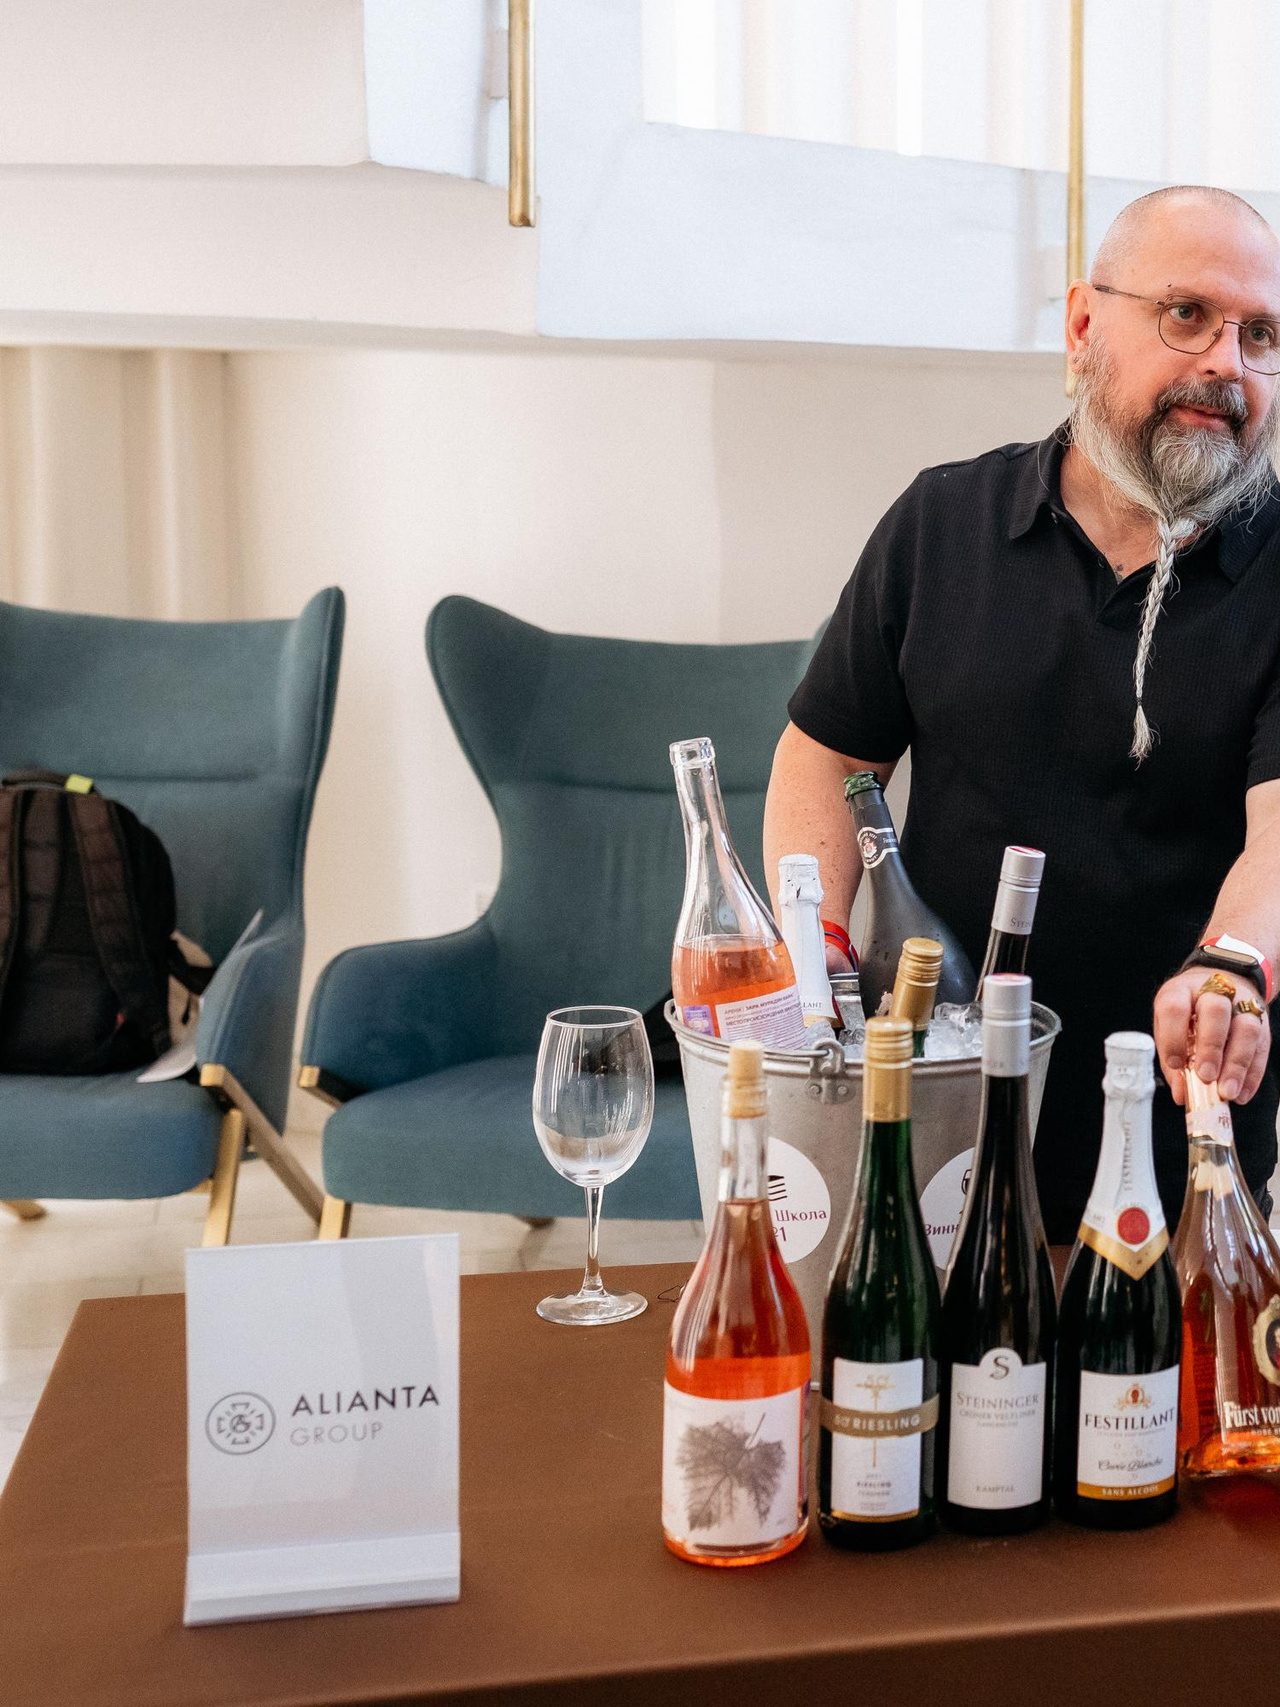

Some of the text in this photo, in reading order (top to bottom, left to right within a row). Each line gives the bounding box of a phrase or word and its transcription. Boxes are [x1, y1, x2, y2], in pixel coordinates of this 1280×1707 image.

[775, 1209, 827, 1222] Школа
[292, 1385, 439, 1417] ALIANTA
[956, 1392, 1039, 1409] STEININGER
[1085, 1407, 1174, 1430] FESTILLANT
[1223, 1400, 1260, 1429] Fürst
[290, 1422, 383, 1446] GROUP
